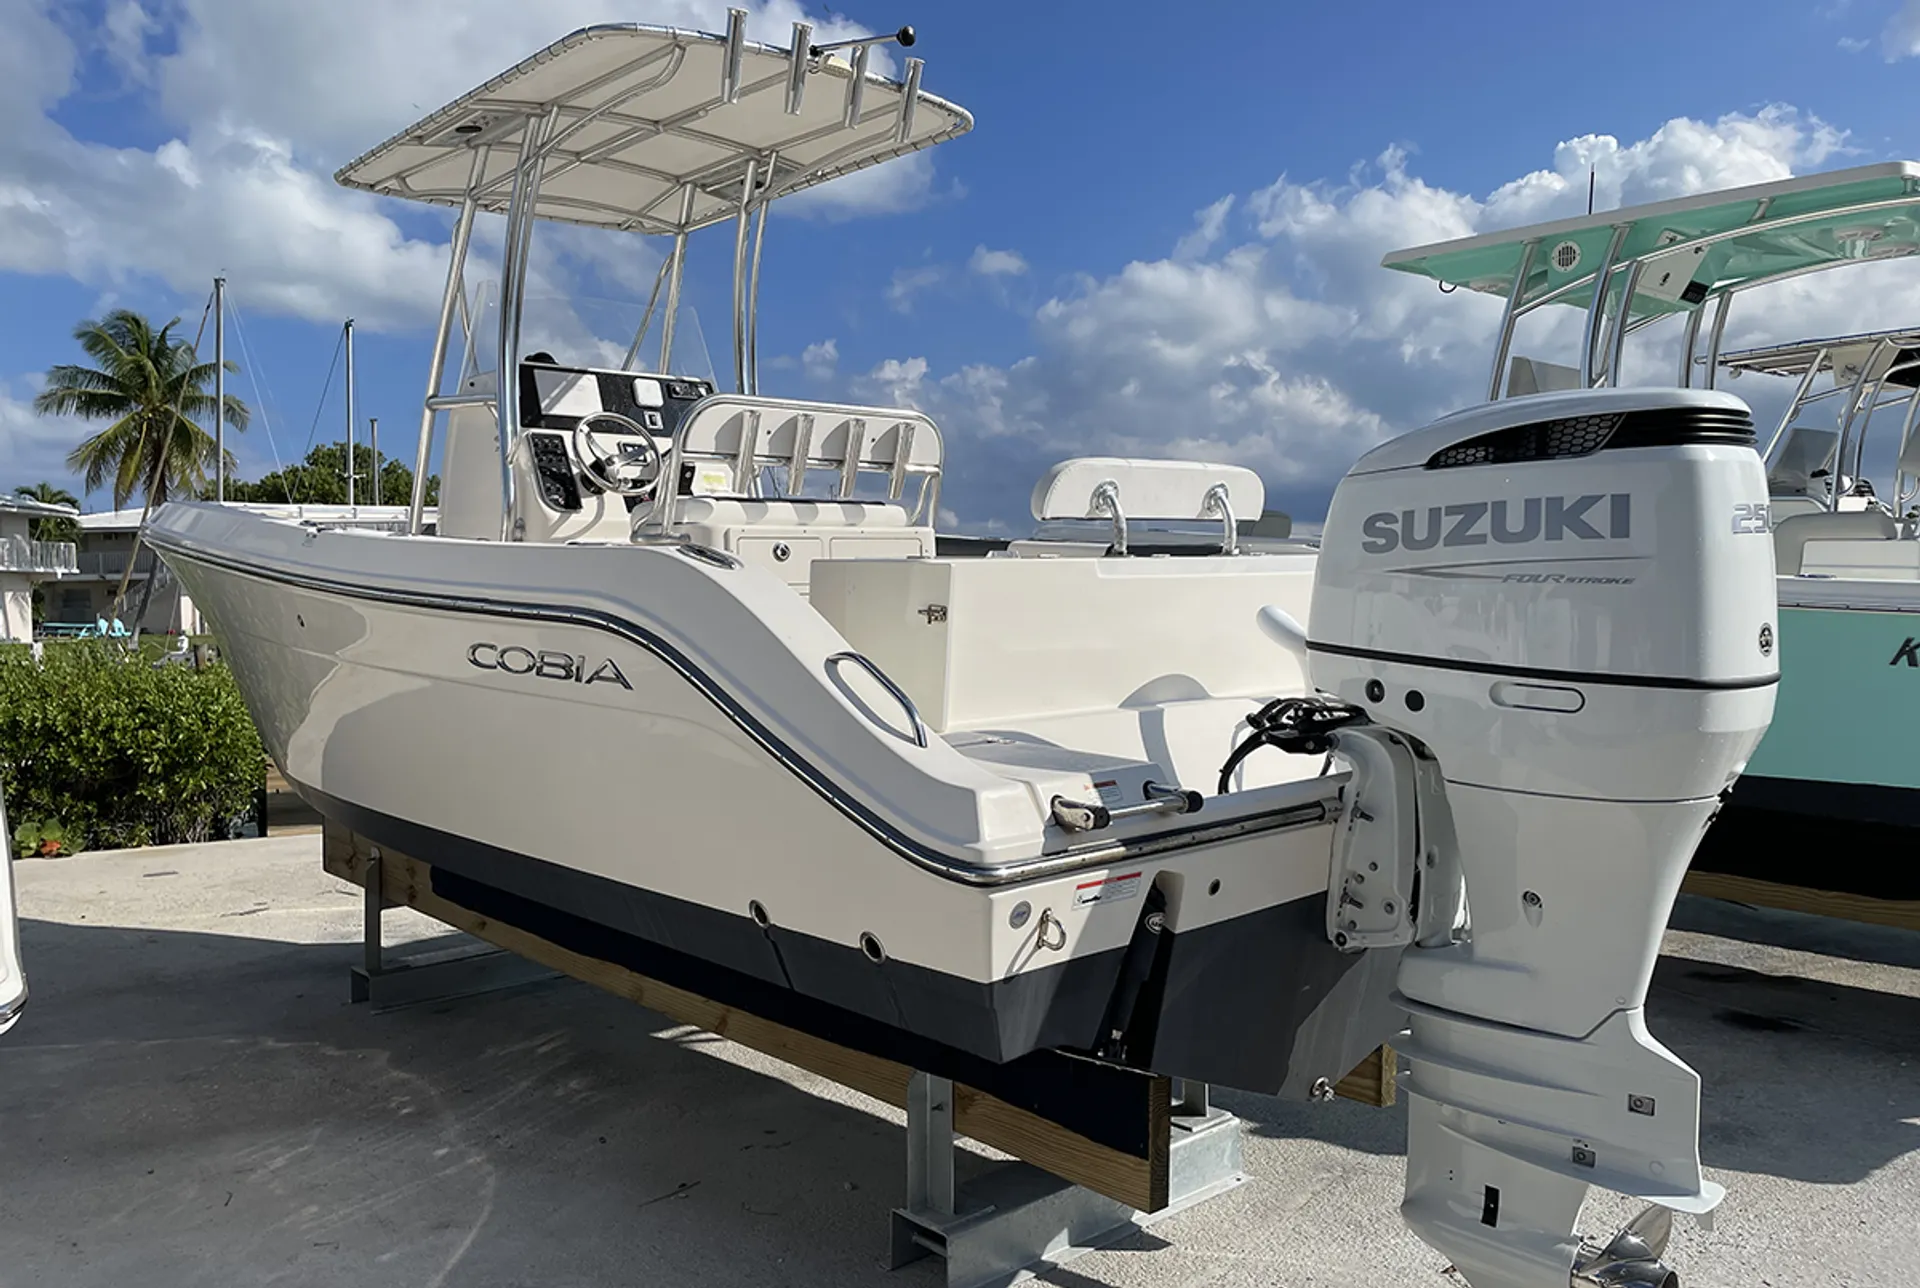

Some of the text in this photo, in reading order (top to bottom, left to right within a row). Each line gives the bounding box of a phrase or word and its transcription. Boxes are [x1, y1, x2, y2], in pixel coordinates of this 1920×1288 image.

[1361, 493, 1631, 555] SUZUKI
[1501, 573, 1565, 583] FOUR
[466, 642, 633, 691] COBIA
